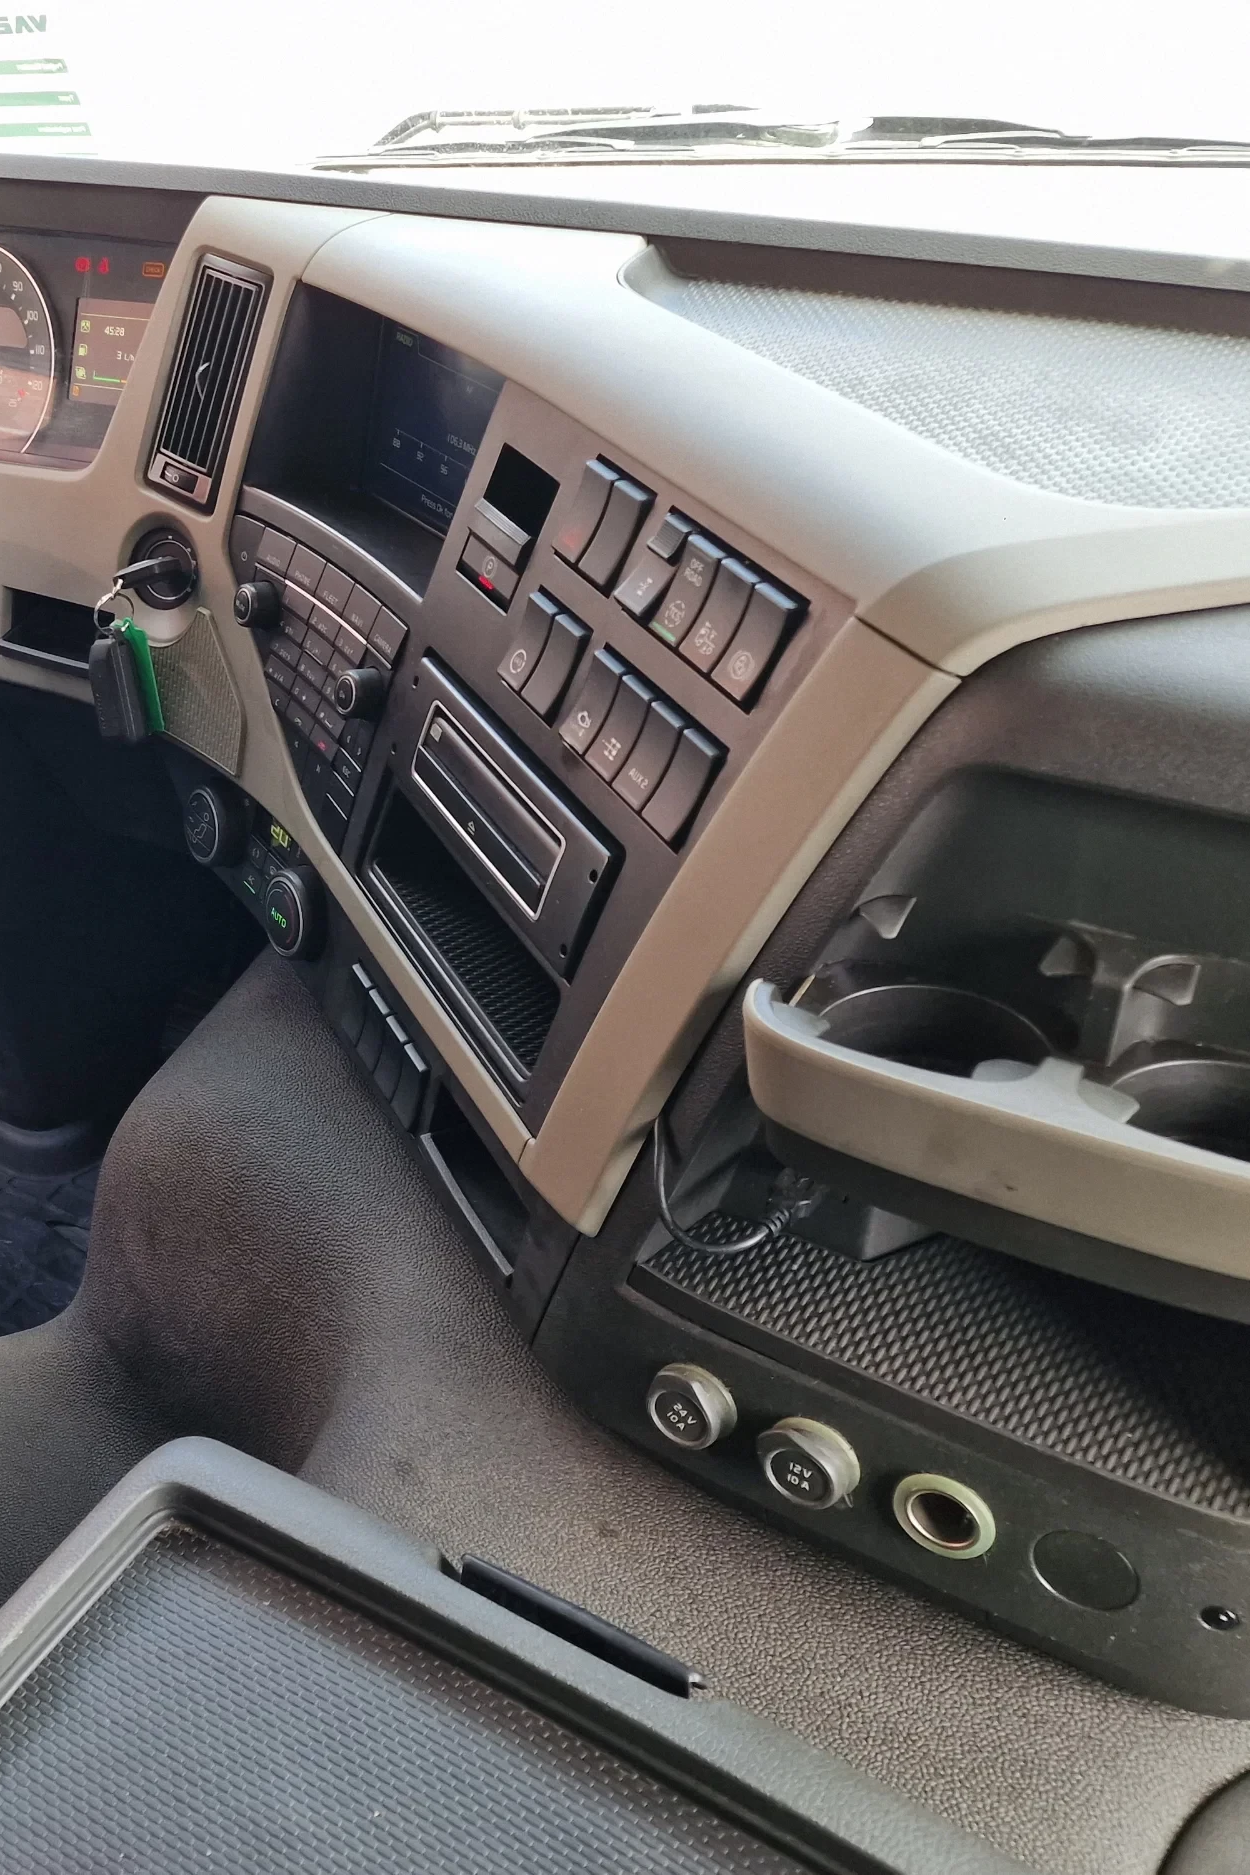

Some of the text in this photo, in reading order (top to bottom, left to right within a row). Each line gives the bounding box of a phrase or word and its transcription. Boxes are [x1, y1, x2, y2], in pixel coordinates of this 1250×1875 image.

[12, 281, 23, 291] 90
[26, 311, 38, 321] 100
[35, 345, 45, 354] 110
[323, 590, 338, 606] FLEET
[373, 633, 392, 654] CAMERA
[270, 906, 287, 929] AUTO
[675, 1421, 685, 1432] A
[800, 1480, 810, 1491] A
